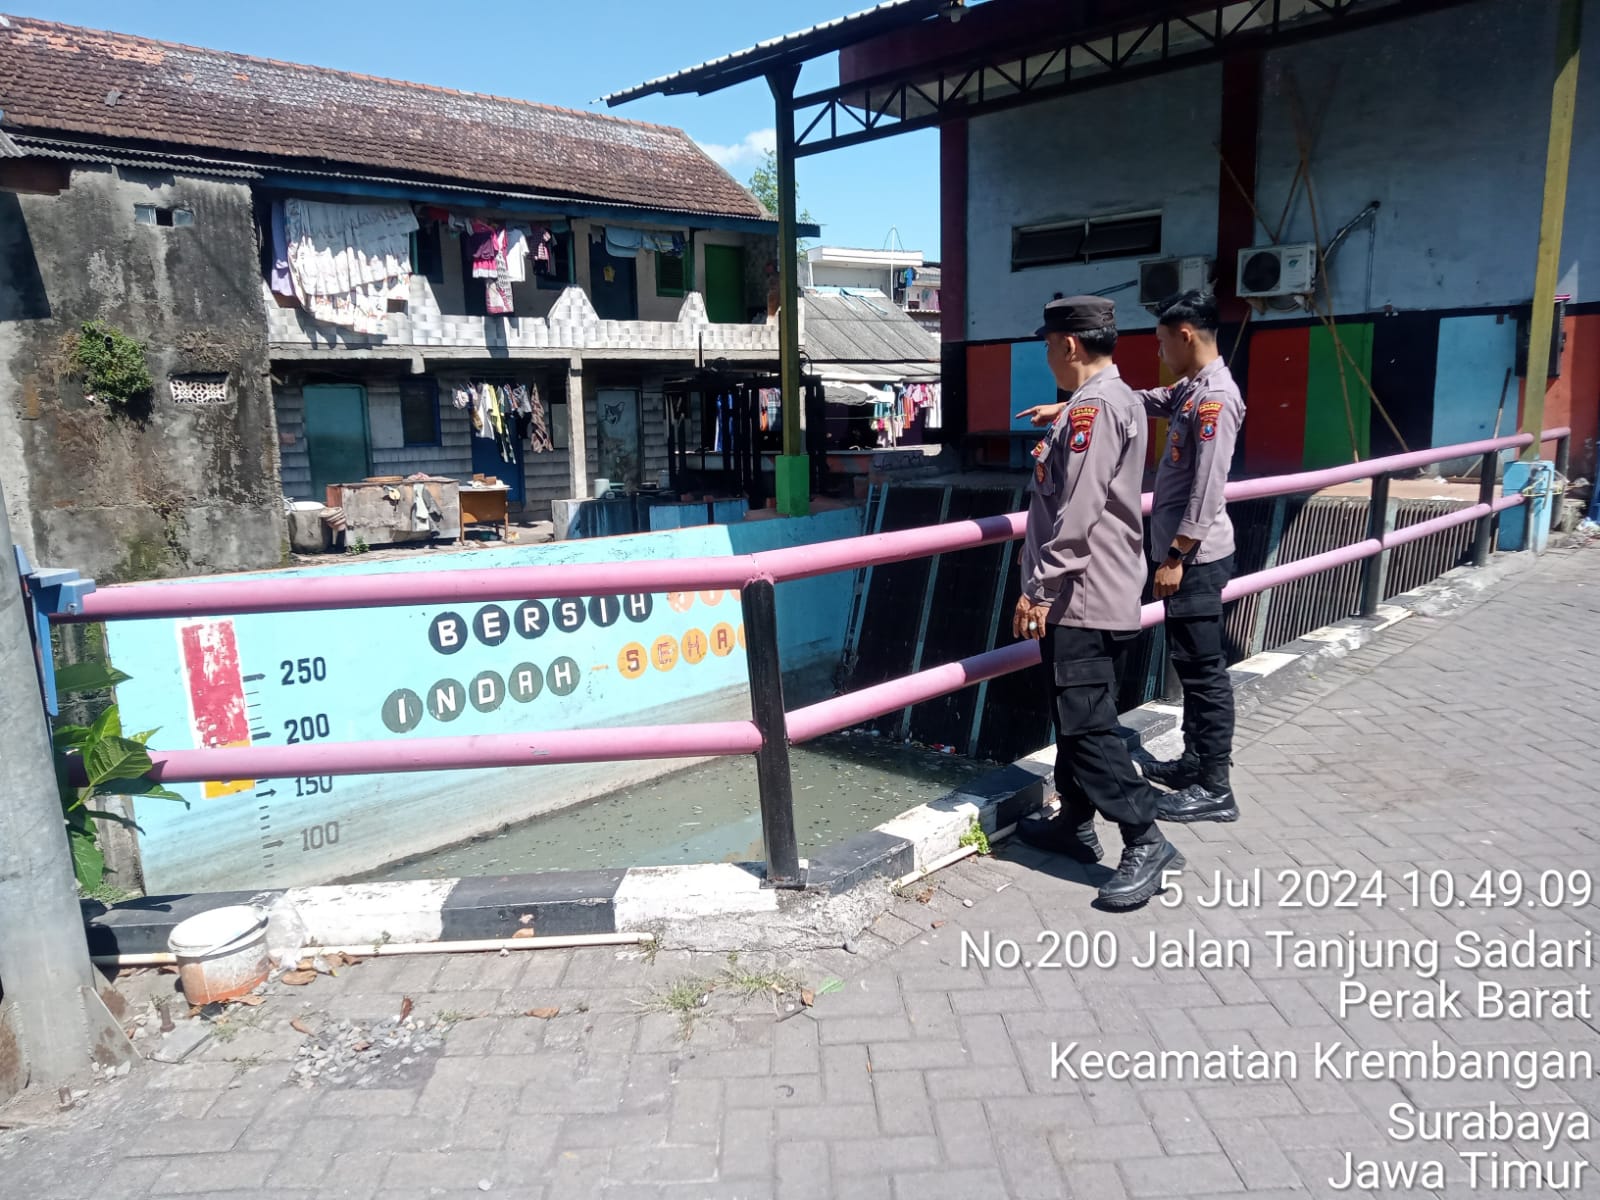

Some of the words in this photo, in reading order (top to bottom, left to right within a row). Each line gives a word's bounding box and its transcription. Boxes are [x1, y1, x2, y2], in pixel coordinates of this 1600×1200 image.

[436, 592, 648, 647] BERSIH
[279, 656, 327, 686] 250
[395, 659, 574, 725] INDAH
[624, 627, 729, 674] SEHA
[283, 713, 331, 745] 200
[294, 775, 333, 797] 150
[301, 820, 340, 851] 100
